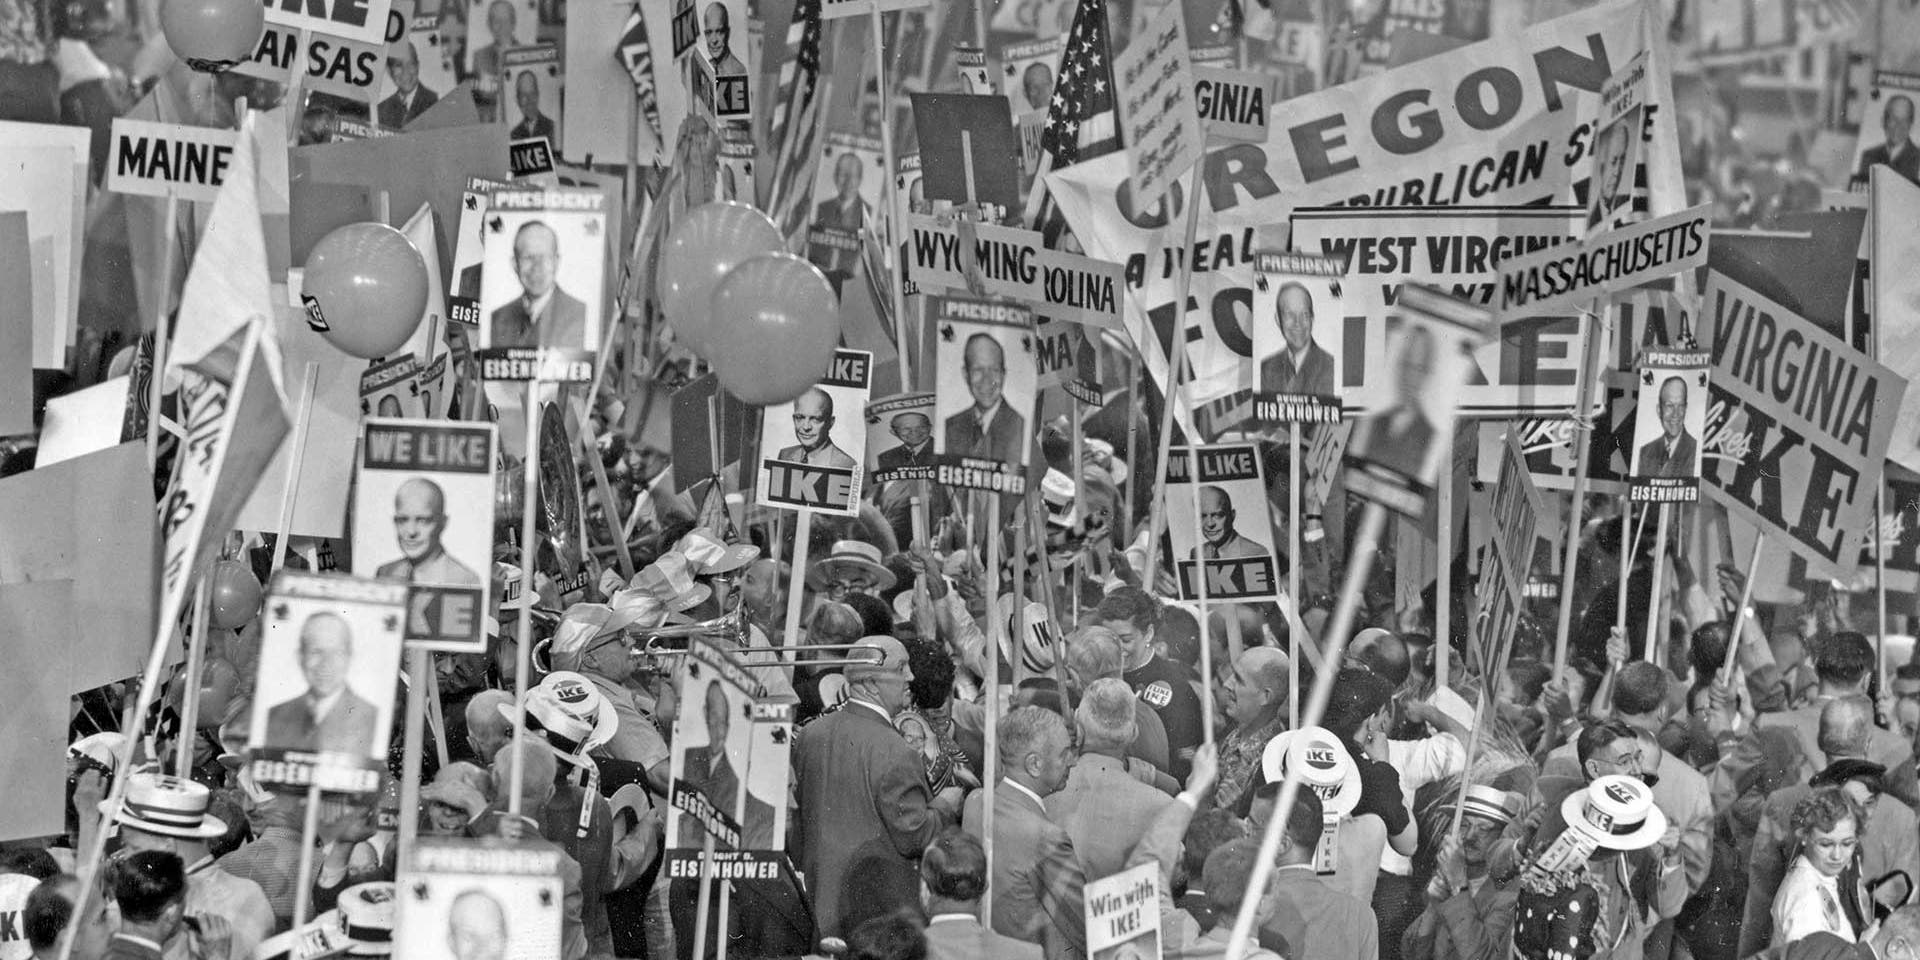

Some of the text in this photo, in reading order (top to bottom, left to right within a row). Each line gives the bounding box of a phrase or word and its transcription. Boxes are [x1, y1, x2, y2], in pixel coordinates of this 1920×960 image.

[675, 11, 698, 52] IK
[253, 30, 378, 87] ANSAS
[716, 80, 746, 111] KE
[1194, 80, 1265, 127] GINIA
[1116, 31, 1612, 230] OREGON
[117, 135, 234, 187] MAINE
[514, 147, 547, 171] IKE
[1261, 253, 1344, 276] PRESIDENT
[1321, 236, 1416, 275] WEST
[1501, 217, 1706, 311] MASSACHUSETTS
[1043, 265, 1117, 314] ROLINA
[946, 300, 1032, 327] PRESIDENT
[1147, 286, 1254, 386] FO
[1341, 316, 1580, 387] IE
[828, 358, 864, 382] IKE
[1649, 352, 1711, 367] PRESIDENT
[1711, 288, 1879, 458] VIRGINIA
[872, 395, 936, 413] PRESIDE
[1257, 400, 1340, 423] EISENHOWER
[368, 430, 486, 467] WE LIKE
[877, 469, 936, 482] EISENHO
[938, 464, 1026, 495] EISENHOWER
[1201, 453, 1253, 477] LIKE
[769, 467, 851, 506] IKE
[1630, 485, 1698, 502] EISENHOWER
[1186, 561, 1269, 595] IKE
[409, 590, 475, 639] KE
[1032, 620, 1052, 648] IK
[556, 686, 586, 700] IKE
[1306, 750, 1335, 762] IKE
[1610, 784, 1635, 803] IKE
[670, 859, 779, 880] EISNHOWER
[697, 851, 740, 861] DIGHT
[1090, 877, 1155, 919] Win with
[1110, 908, 1142, 938] IKE!
